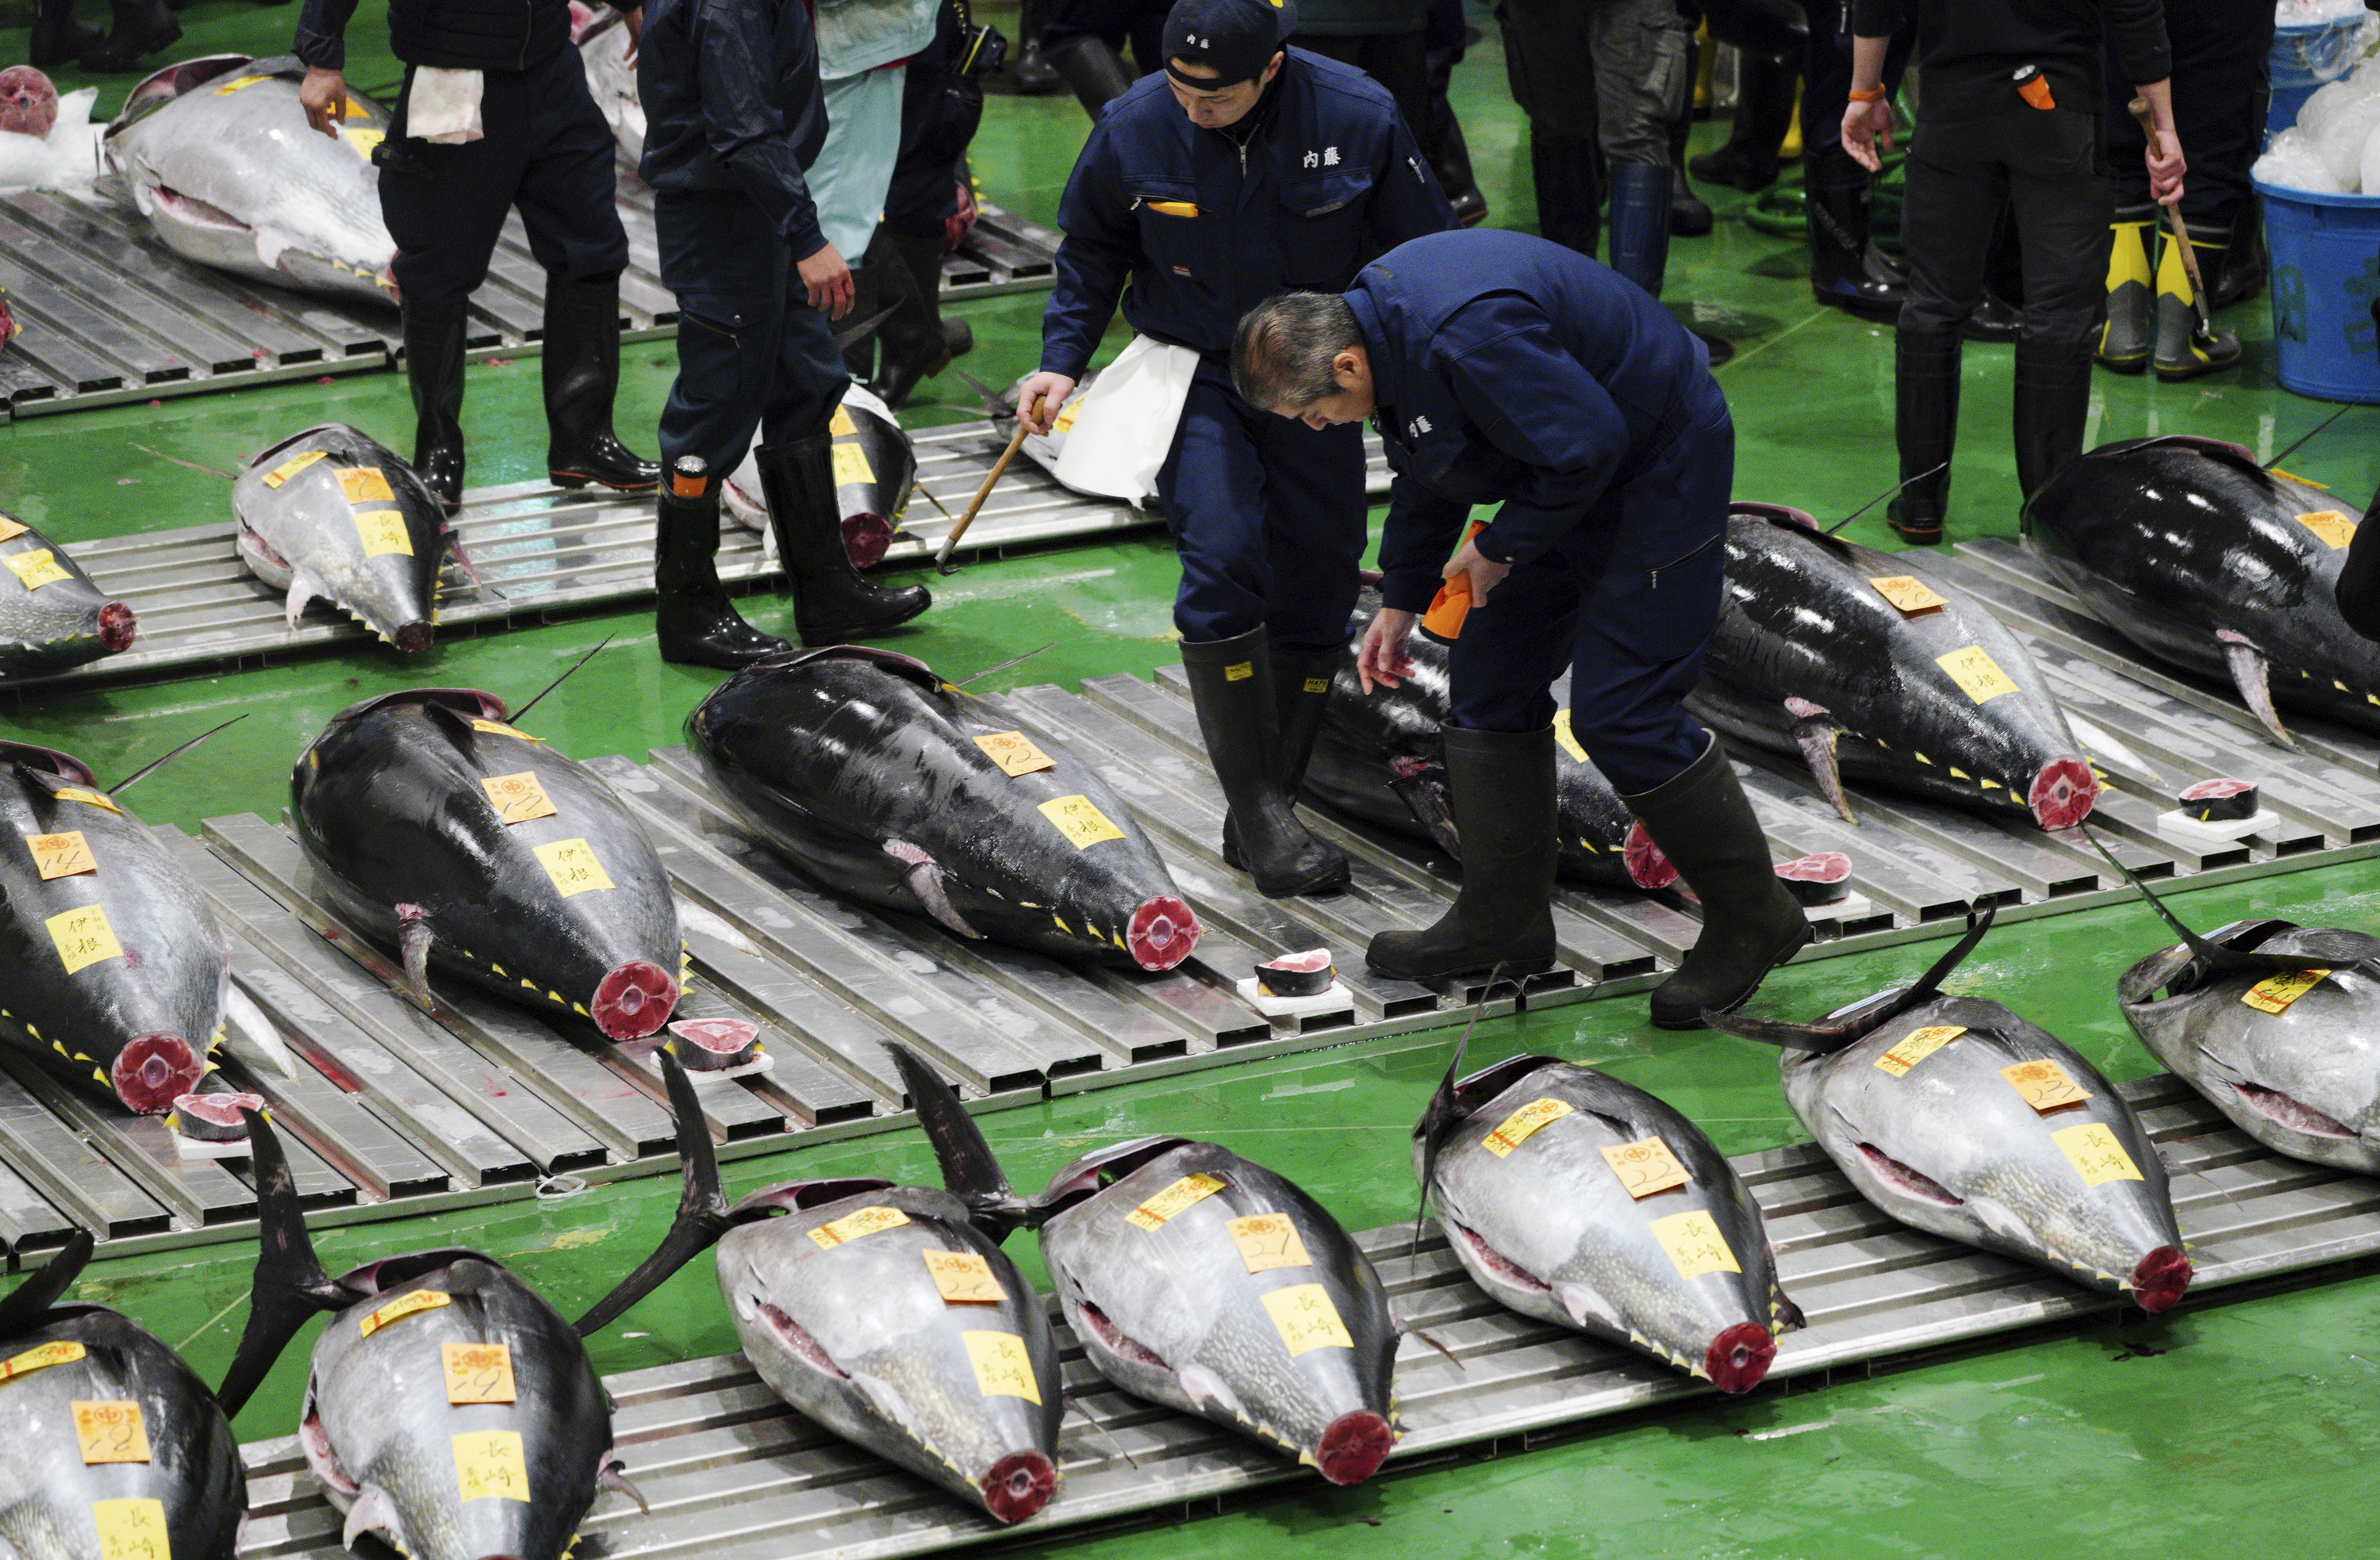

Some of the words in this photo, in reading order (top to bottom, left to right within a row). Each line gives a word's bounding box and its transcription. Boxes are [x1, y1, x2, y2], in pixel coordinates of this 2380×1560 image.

[1303, 147, 1342, 168] 内藤
[374, 515, 401, 545] 長崎
[1960, 657, 1999, 688] 伊根
[1005, 749, 1043, 765] 12
[1063, 803, 1104, 833] 伊根
[44, 851, 85, 870] 14
[558, 849, 594, 882] 伊根
[68, 917, 102, 954] 伊根
[2032, 1080, 2075, 1104] 23
[2084, 1131, 2125, 1171] 長崎
[1631, 1160, 1680, 1188] 22
[1681, 1220, 1722, 1261] 長崎
[1293, 1293, 1334, 1336] 長崎
[992, 1340, 1027, 1389] 長崎
[479, 1439, 515, 1487] 長崎
